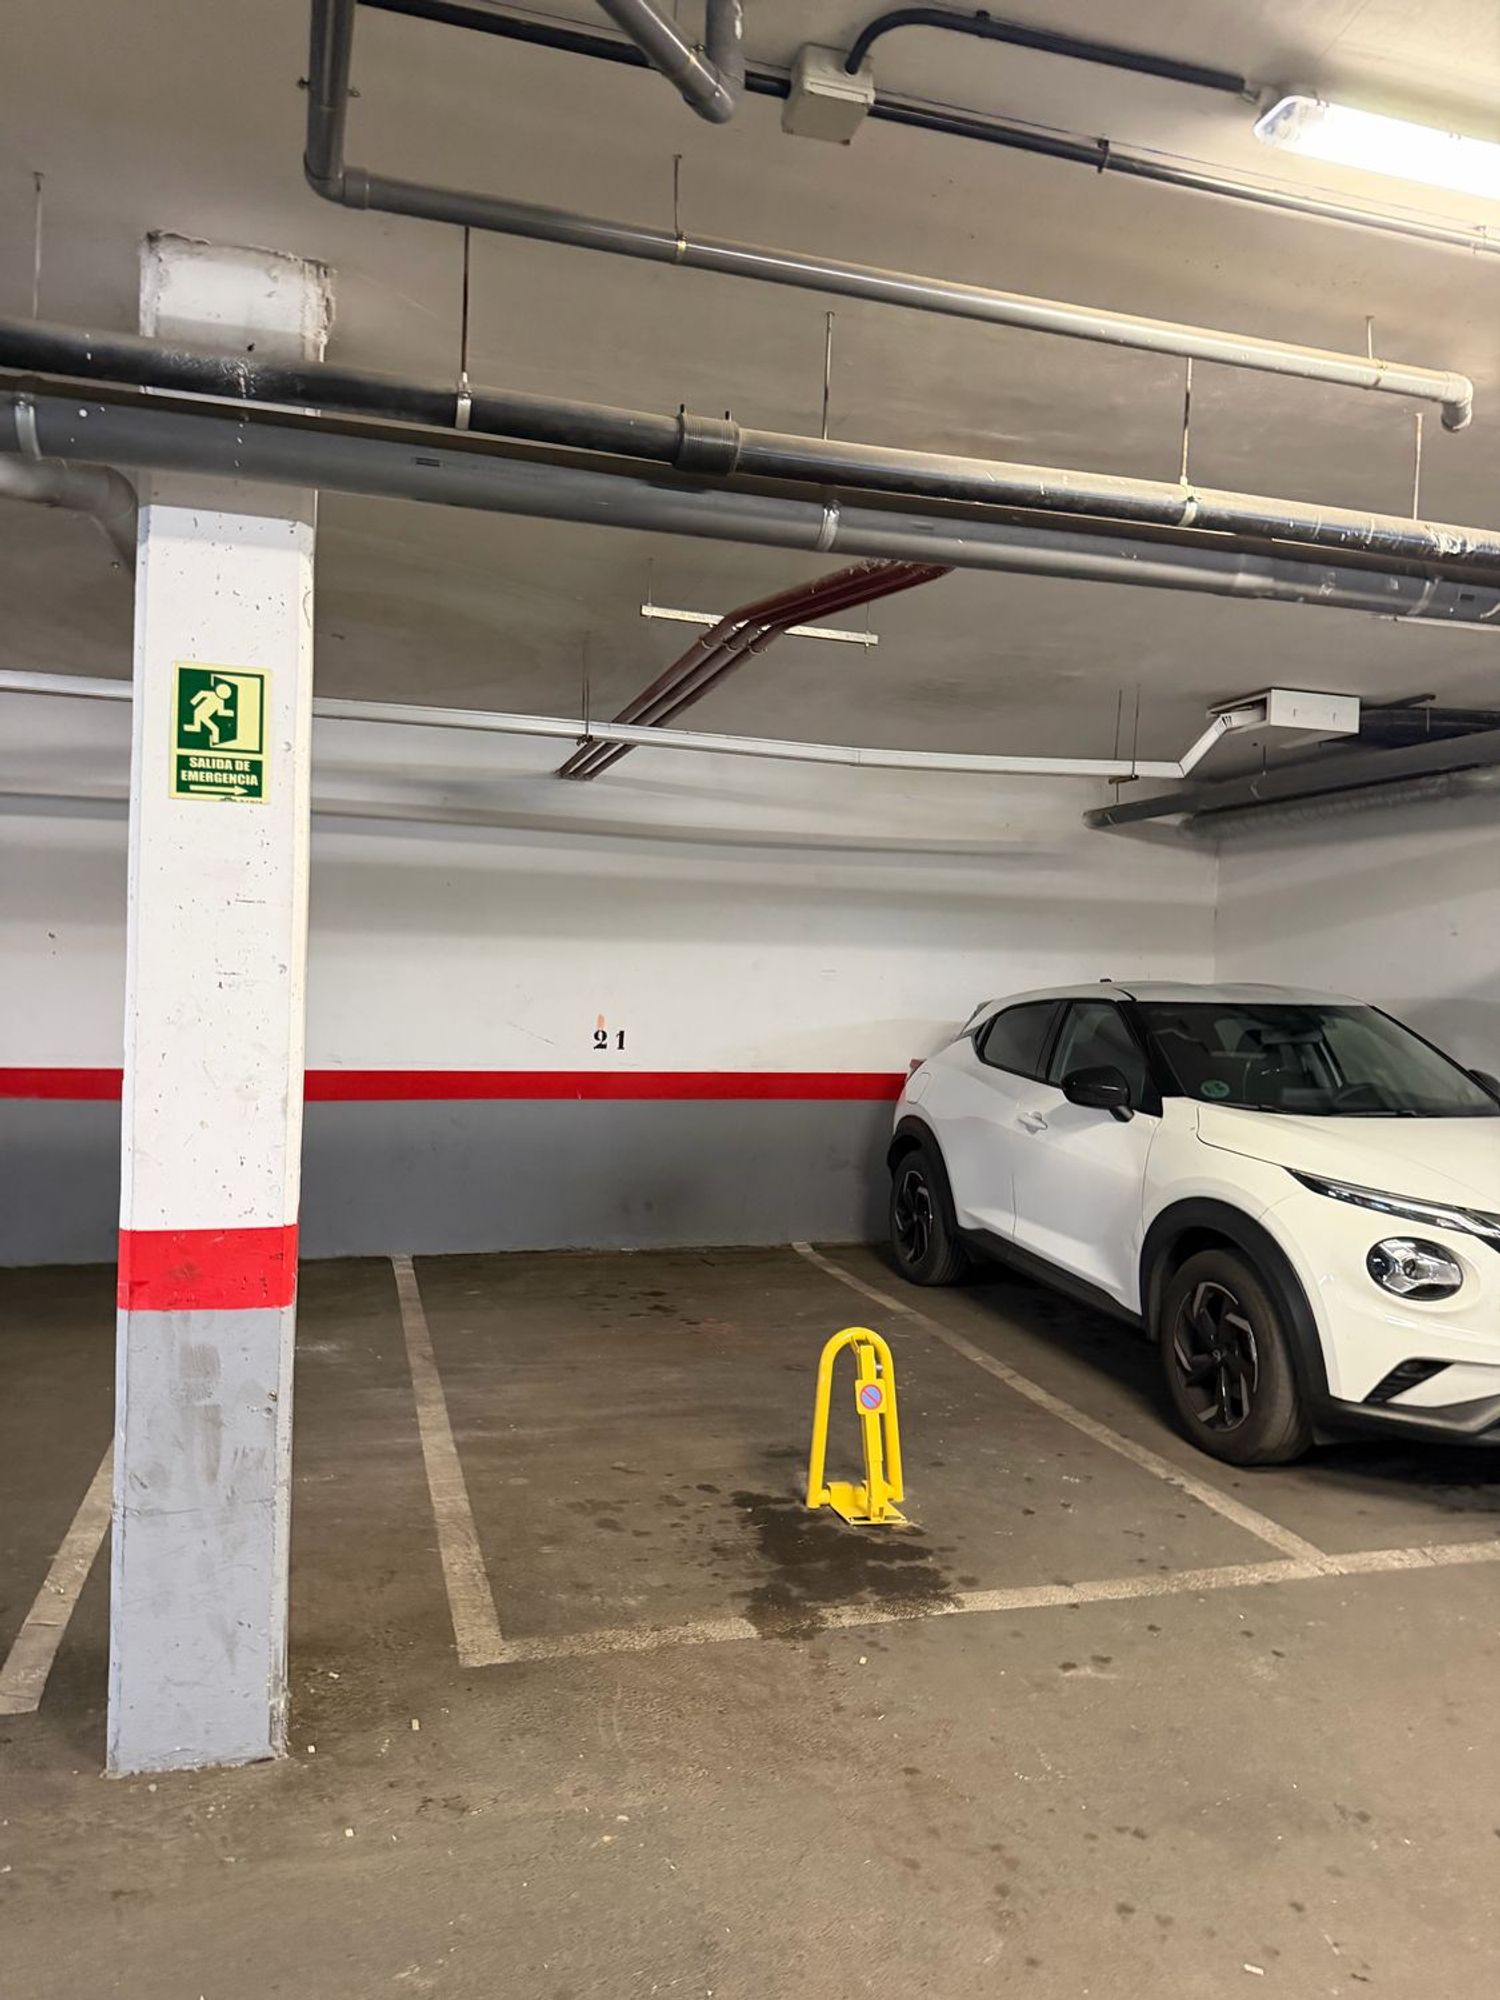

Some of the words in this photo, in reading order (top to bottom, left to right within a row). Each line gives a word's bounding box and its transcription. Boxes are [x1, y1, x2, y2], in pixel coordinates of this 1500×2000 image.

[189, 757, 233, 770] SALIDA
[235, 760, 251, 772] DE
[181, 770, 259, 786] EMERGENCIA
[593, 1029, 625, 1051] 21
